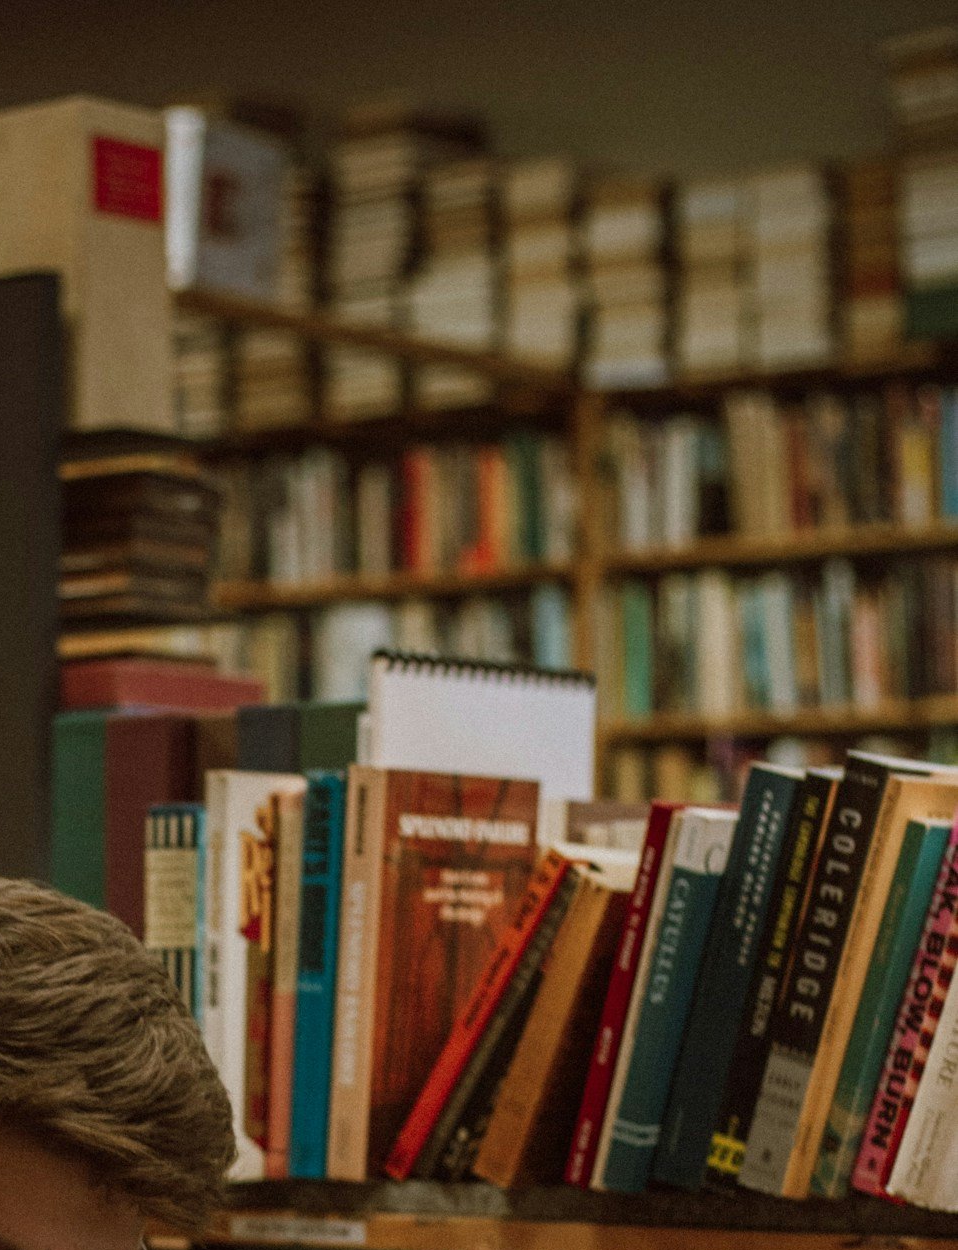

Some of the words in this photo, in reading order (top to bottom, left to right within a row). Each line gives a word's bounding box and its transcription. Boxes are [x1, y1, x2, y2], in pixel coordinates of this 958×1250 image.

[649, 877, 690, 1004] CATULLUS
[789, 807, 862, 1024] COLERIDGE
[897, 930, 947, 1034] BLOW,
[871, 1048, 913, 1151] BURN
